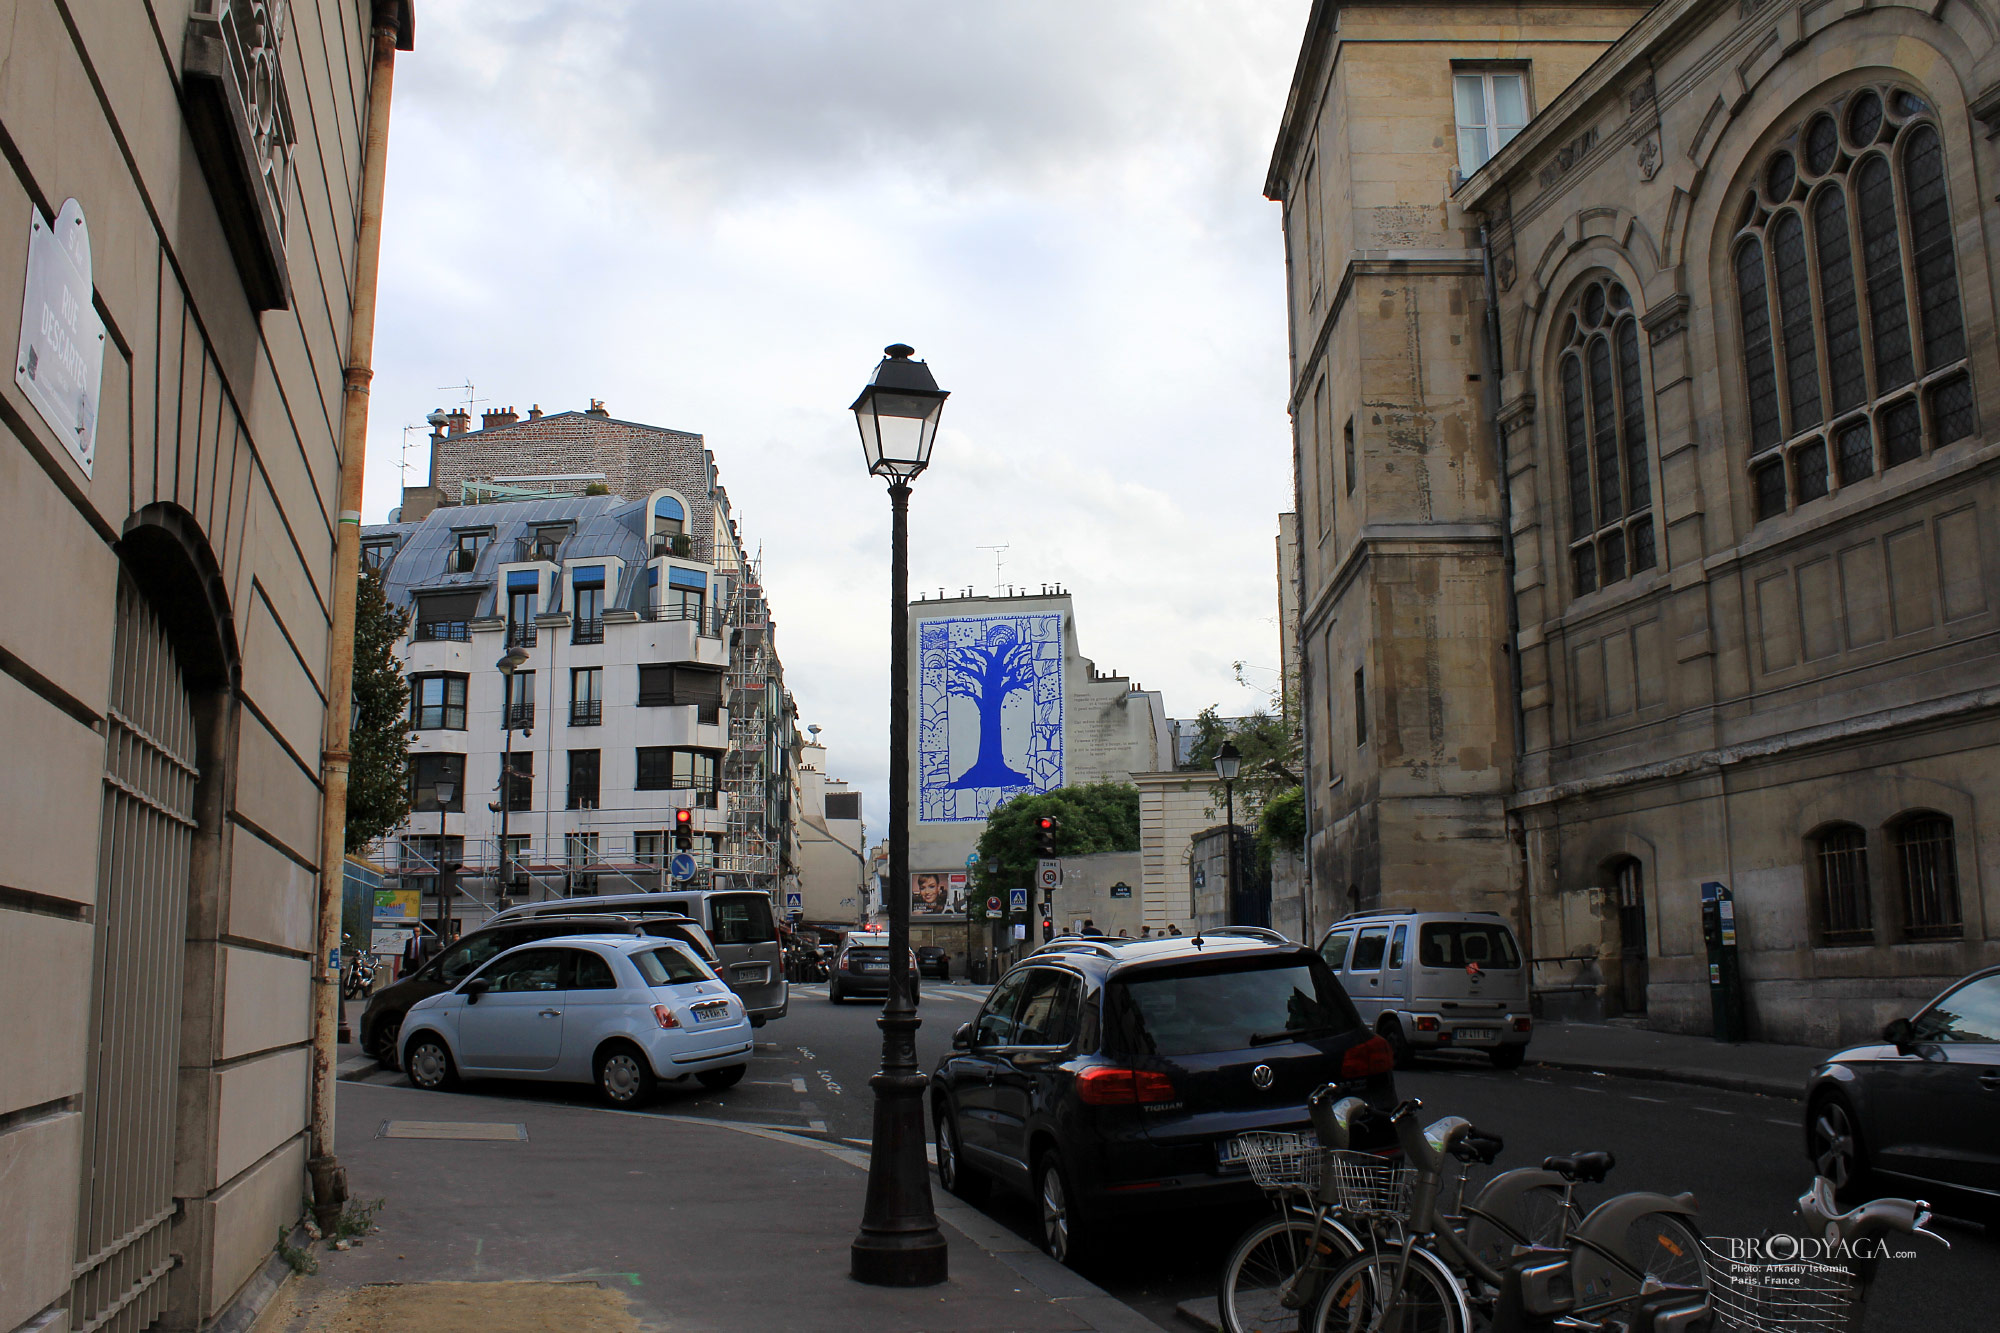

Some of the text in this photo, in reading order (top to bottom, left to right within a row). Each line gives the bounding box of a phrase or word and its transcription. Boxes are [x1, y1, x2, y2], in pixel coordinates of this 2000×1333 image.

[61, 283, 80, 335] RUE
[40, 301, 88, 391] DESCARTES
[1046, 873, 1054, 881] 30
[1715, 887, 1724, 901] P
[1143, 1102, 1184, 1112] TIGUAN
